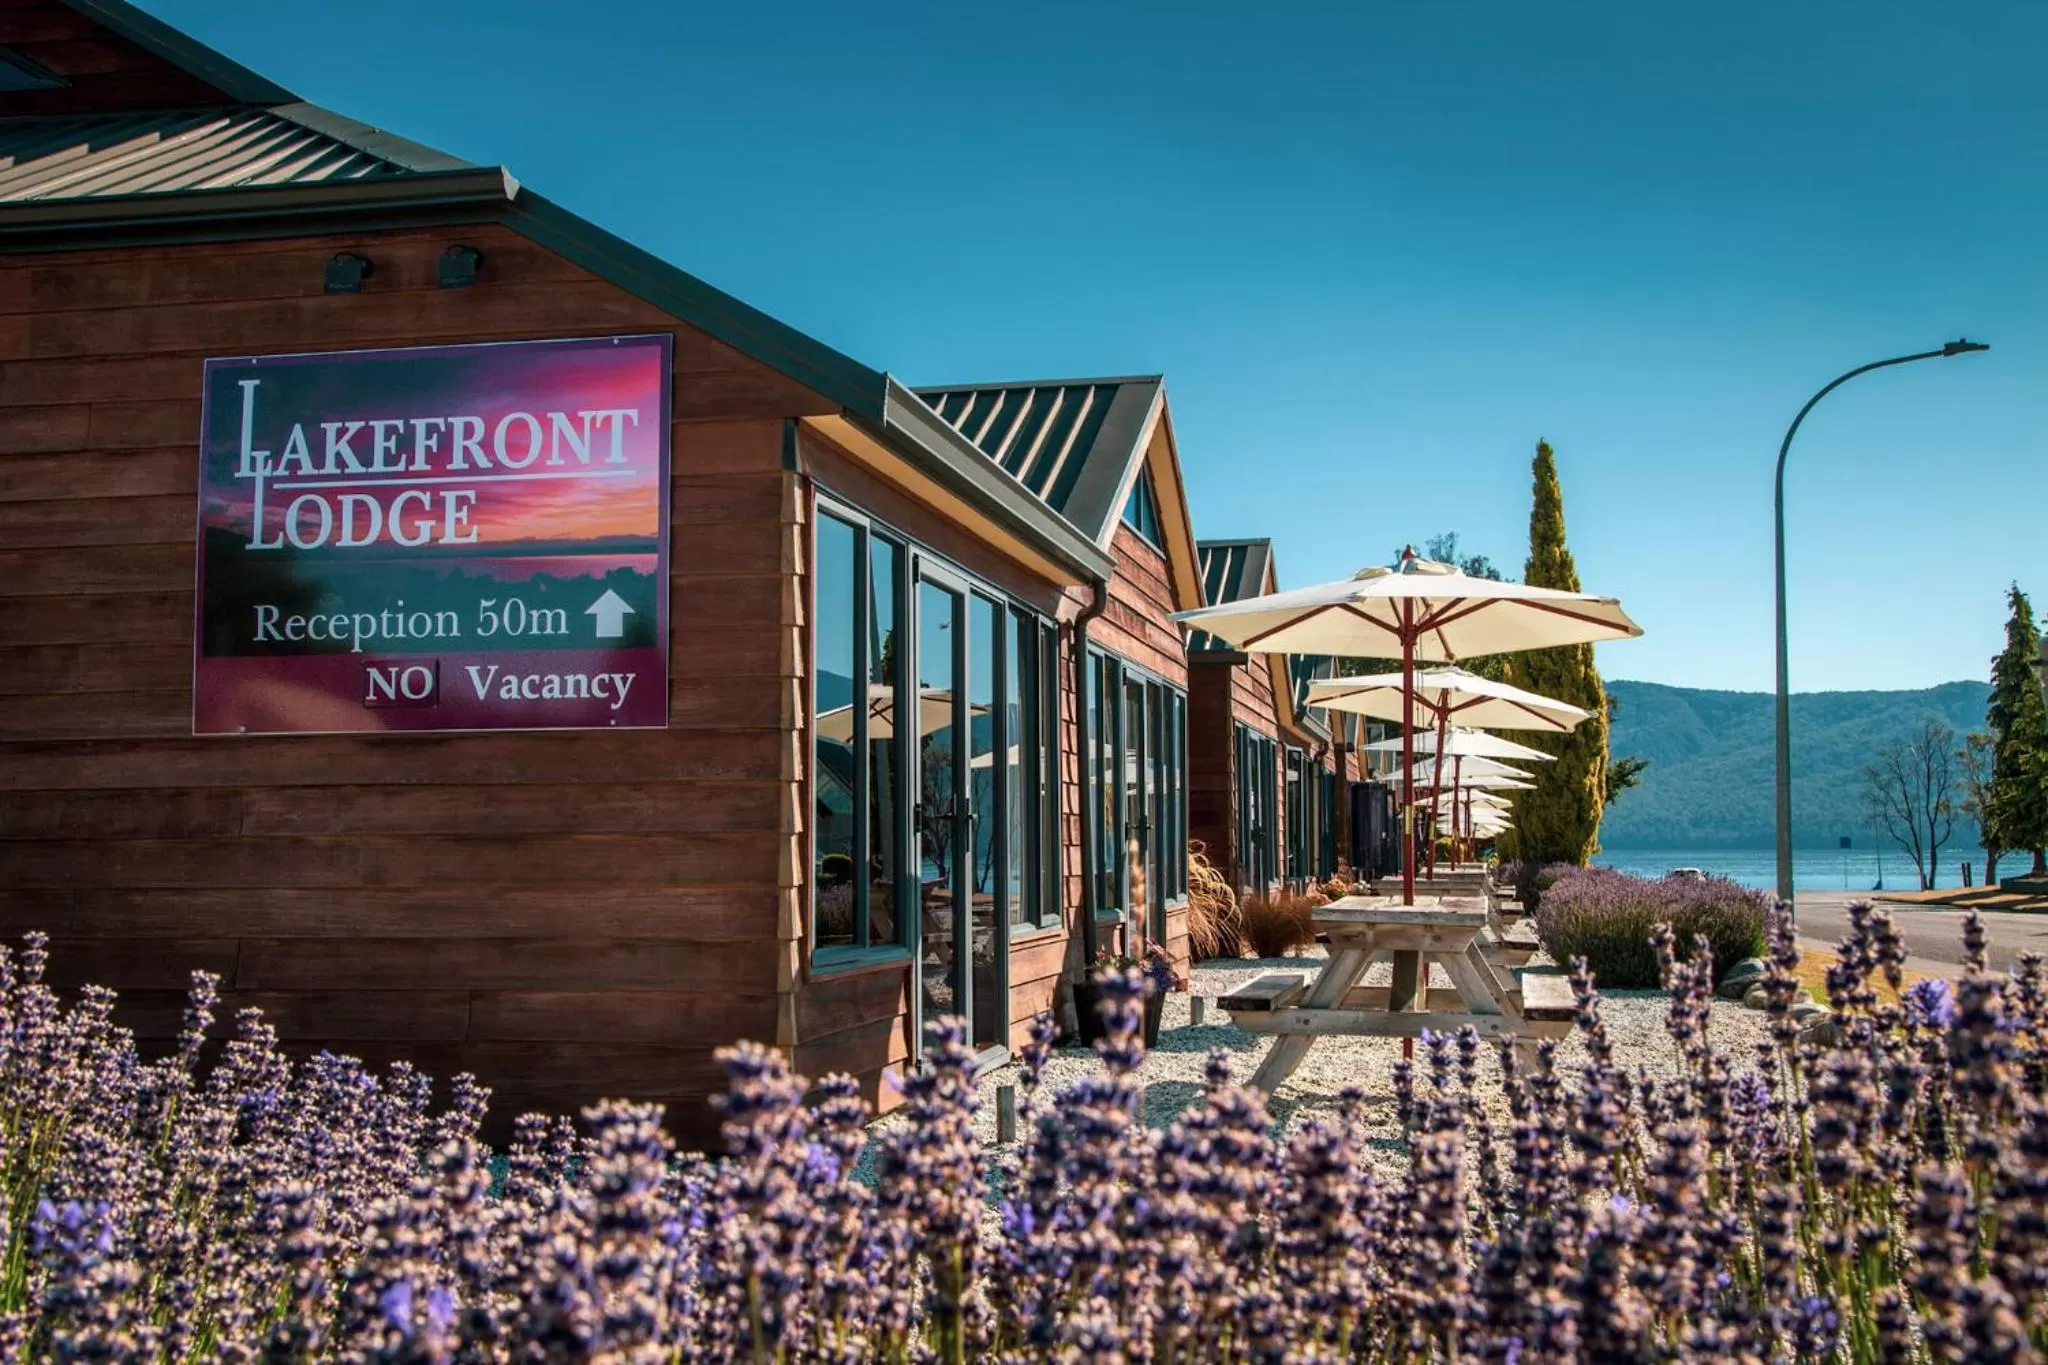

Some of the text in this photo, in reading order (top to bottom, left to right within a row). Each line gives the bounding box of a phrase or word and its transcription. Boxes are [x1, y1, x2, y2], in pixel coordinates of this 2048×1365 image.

[234, 379, 640, 478] LAKEFRONT
[245, 450, 479, 551] LODGE
[252, 598, 569, 653] Reception 50m
[365, 665, 636, 709] NO Vacancy
